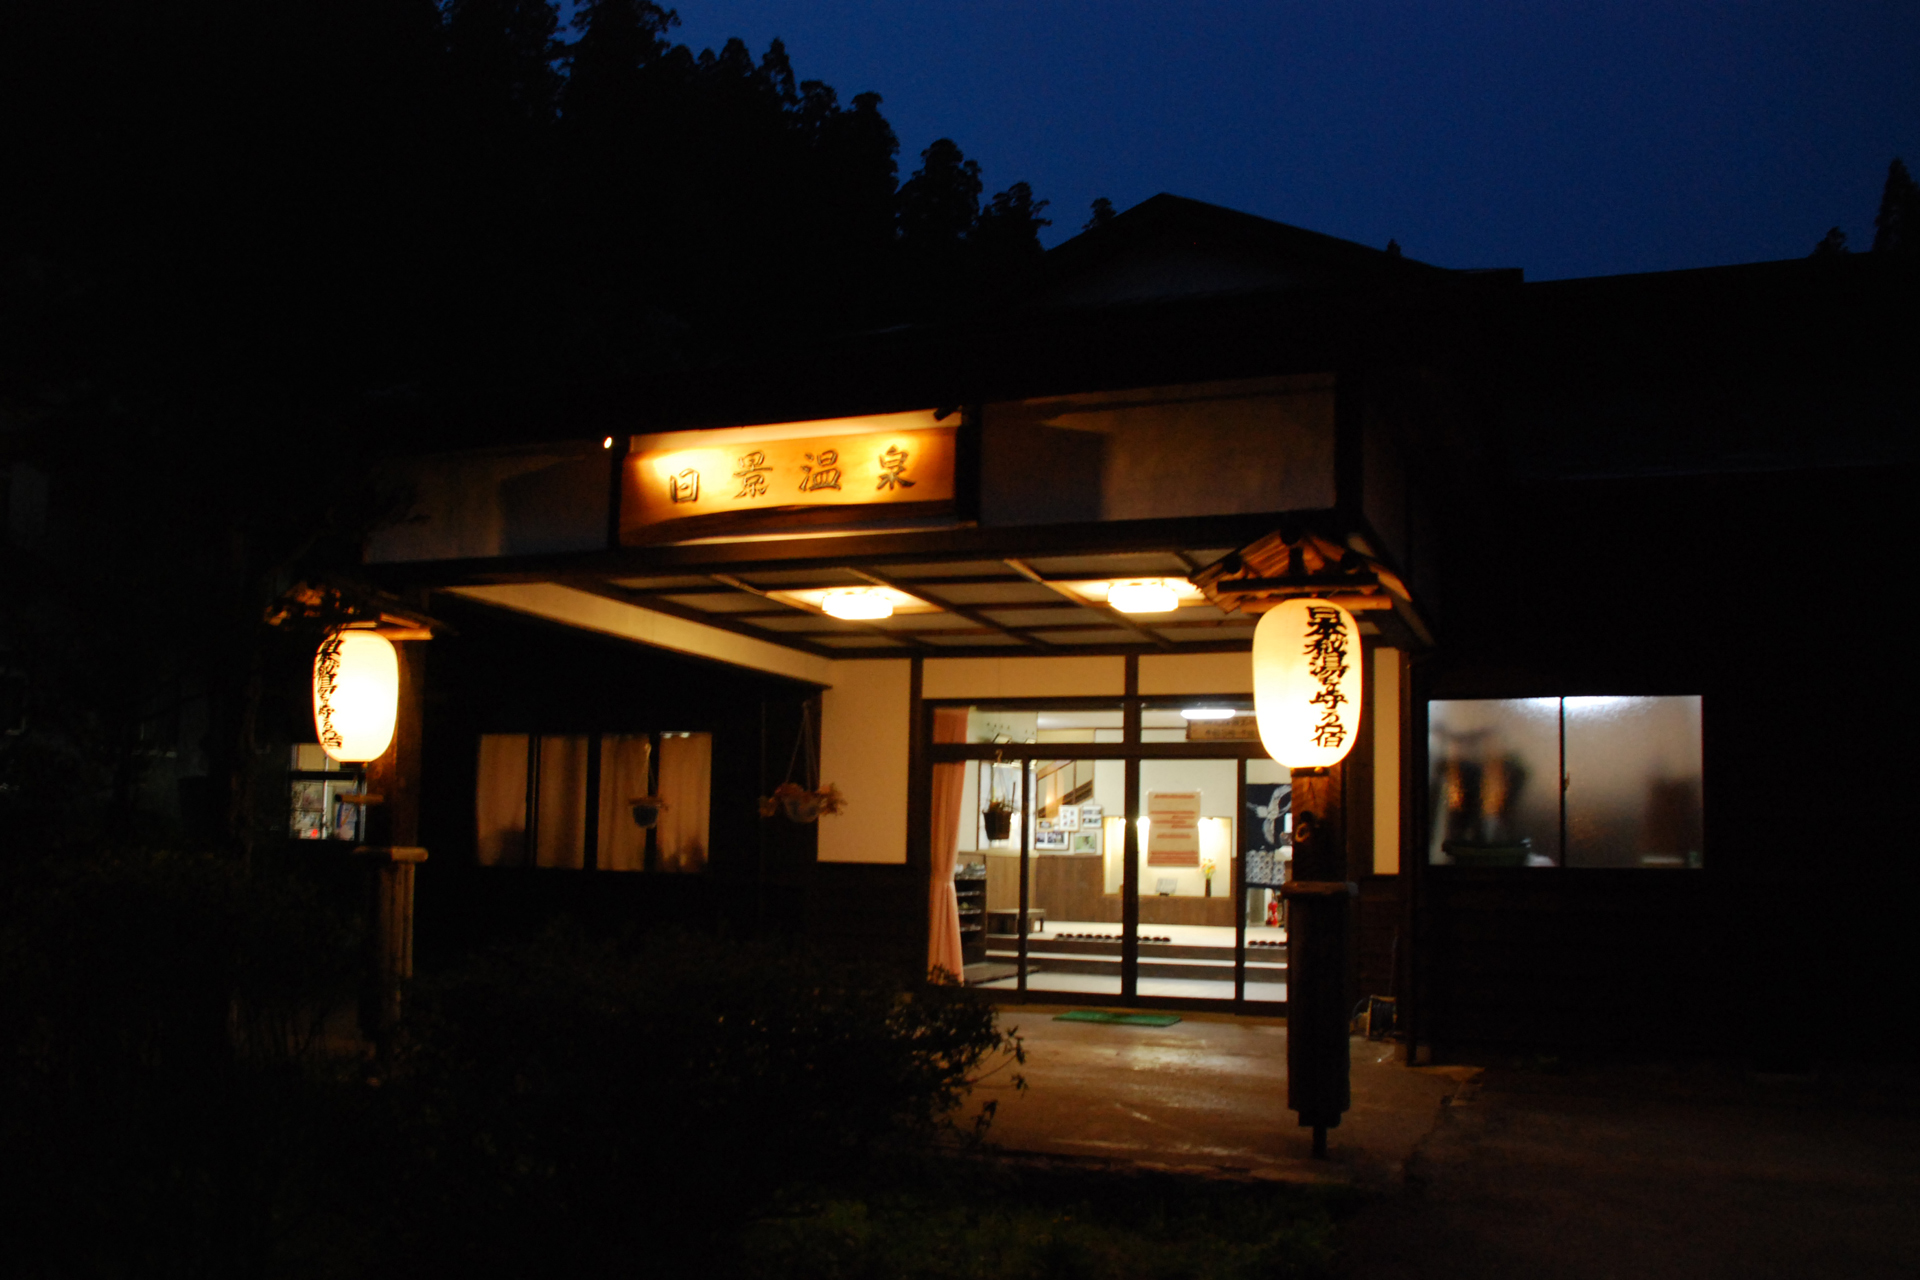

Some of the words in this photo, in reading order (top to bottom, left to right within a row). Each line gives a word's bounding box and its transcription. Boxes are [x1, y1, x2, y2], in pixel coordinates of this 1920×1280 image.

[669, 445, 915, 503] 日景温泉
[1303, 606, 1349, 748] 日本秘湯を守る宿
